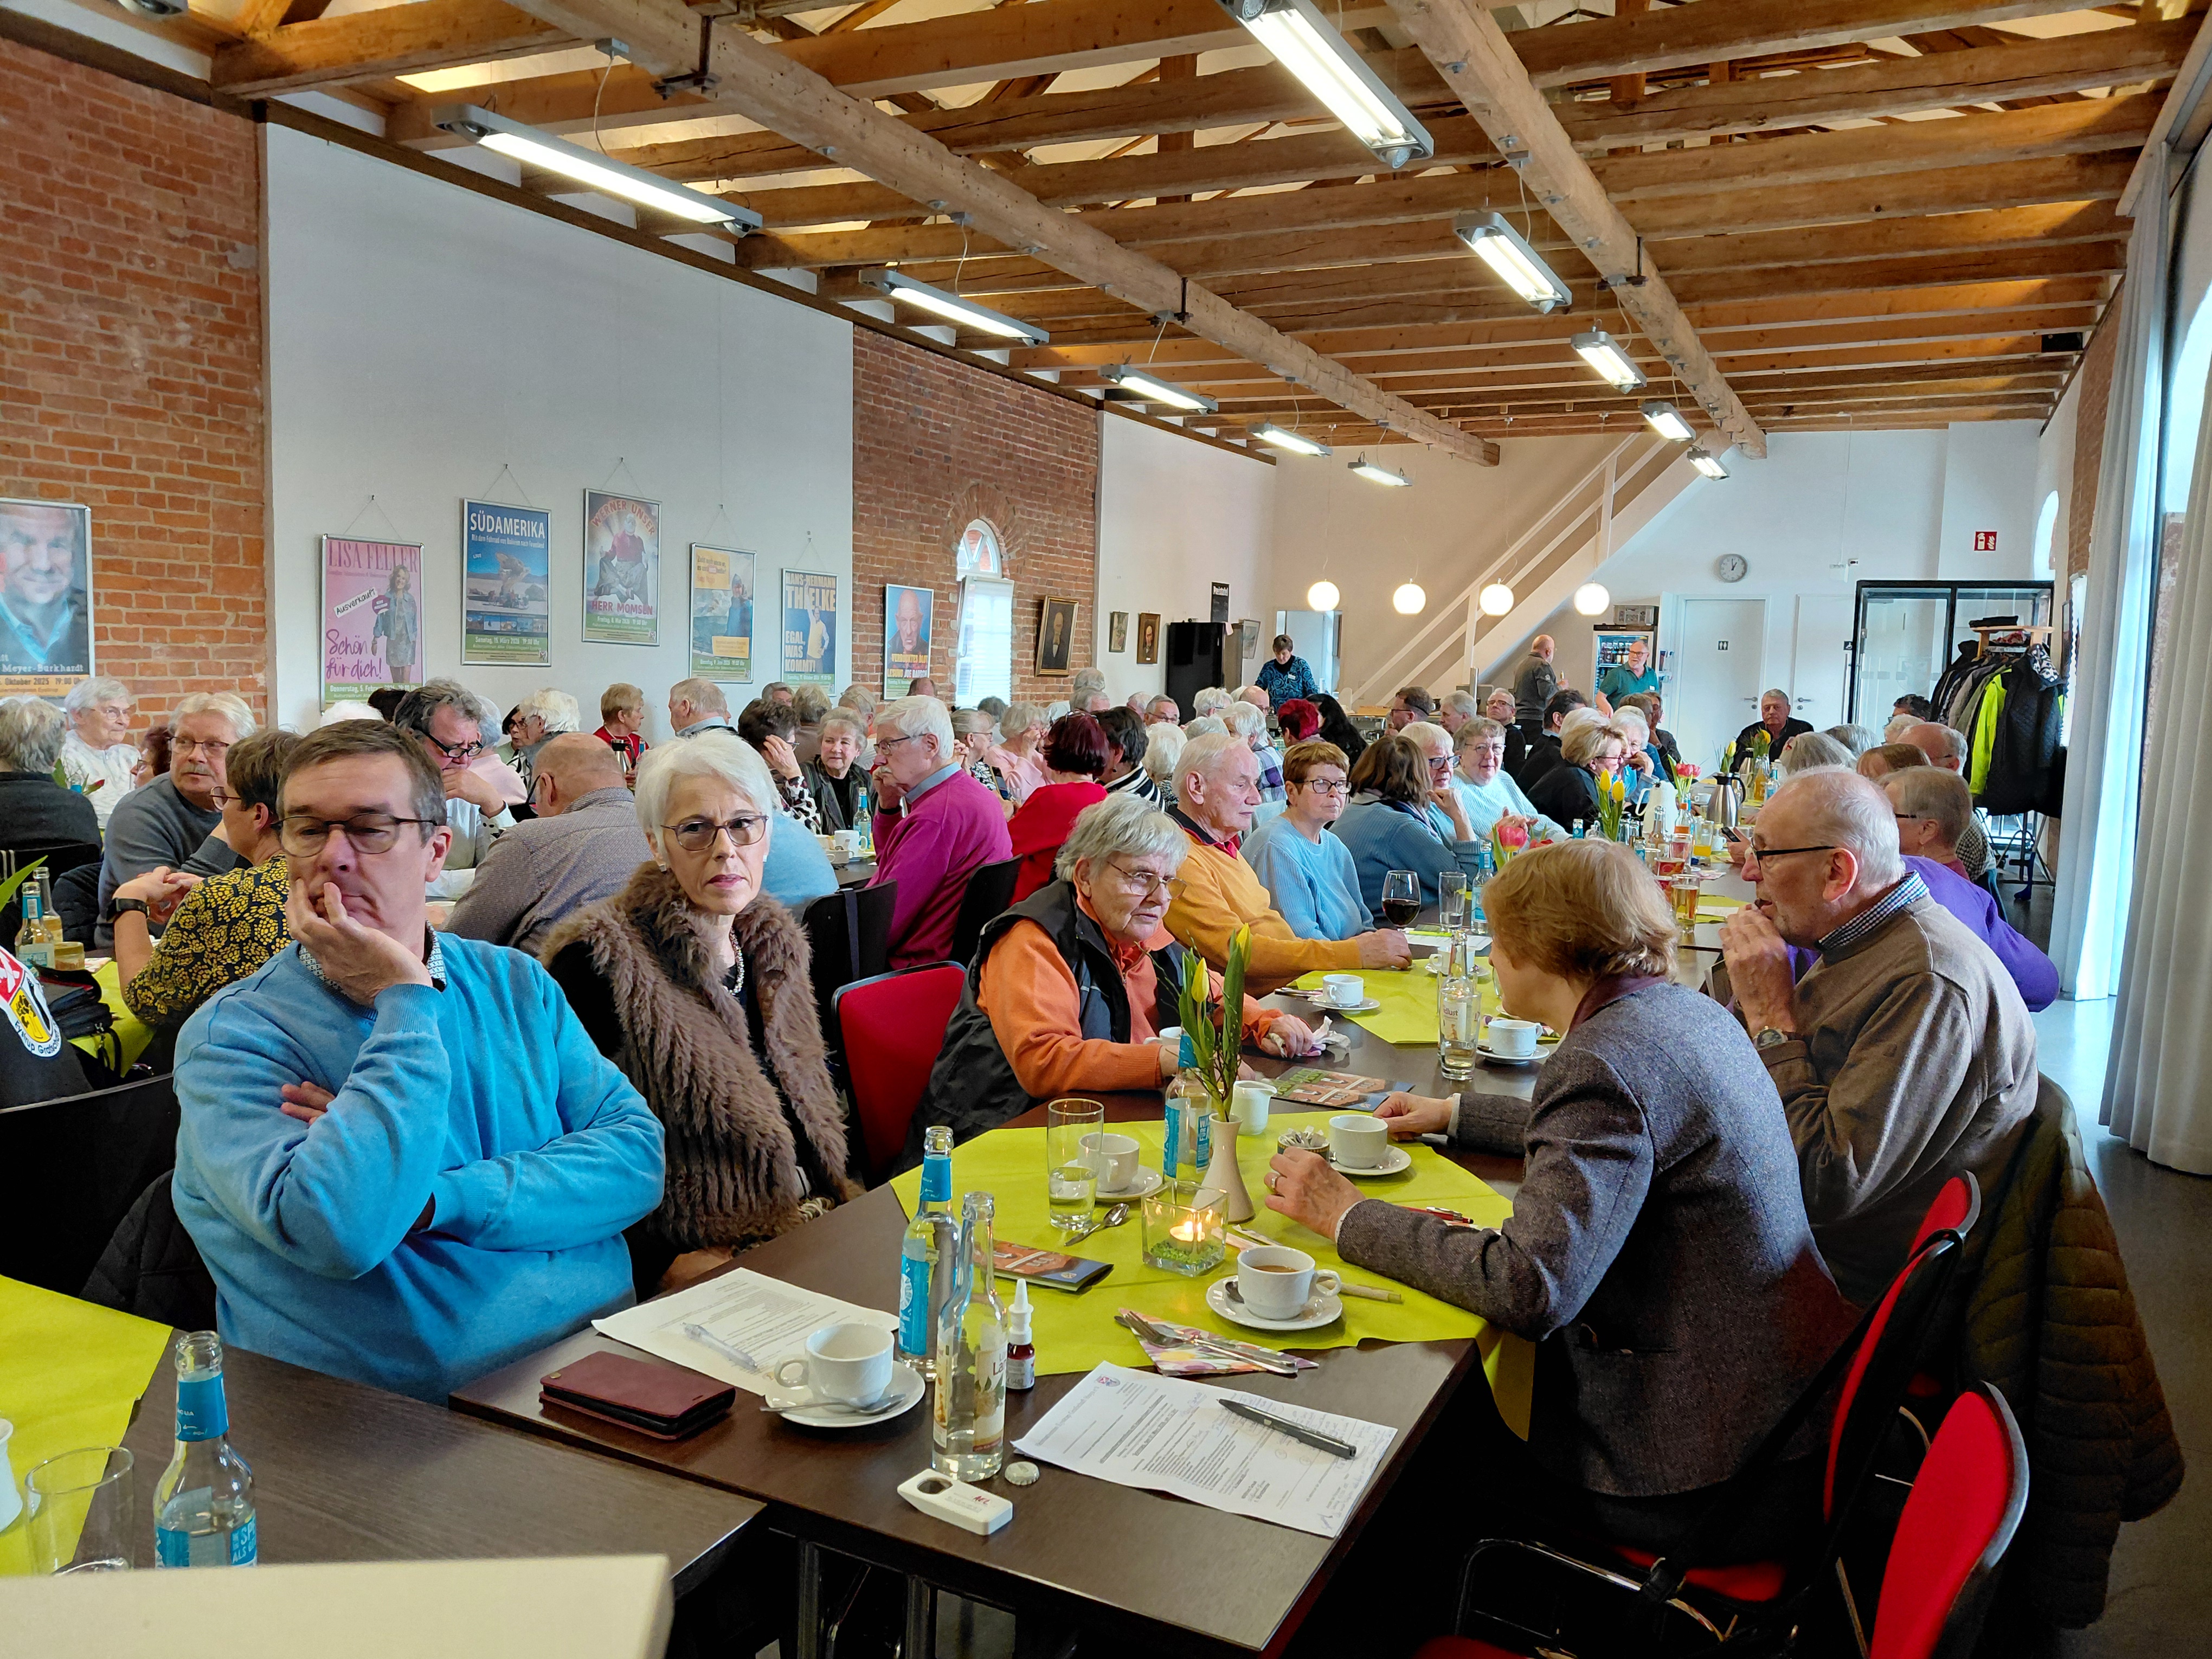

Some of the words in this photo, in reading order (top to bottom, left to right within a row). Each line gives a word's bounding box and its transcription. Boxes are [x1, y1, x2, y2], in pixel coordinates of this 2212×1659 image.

[470, 510, 545, 539] SÜDAMERIKA
[592, 500, 627, 527] WERNER
[631, 504, 655, 536] UNSER
[329, 541, 362, 569] LISA
[366, 544, 417, 573] FELLER
[336, 588, 376, 615] Ausverkauft
[591, 601, 613, 611] HERR
[617, 602, 653, 615] MOMSEN
[326, 629, 367, 655] Schön
[785, 631, 806, 646] EGAL,
[785, 645, 803, 658] WAS
[2, 664, 83, 674] Meyer-Burkhardt
[326, 657, 350, 679] für
[350, 658, 382, 680] dich!
[785, 659, 816, 672] KOMMT!
